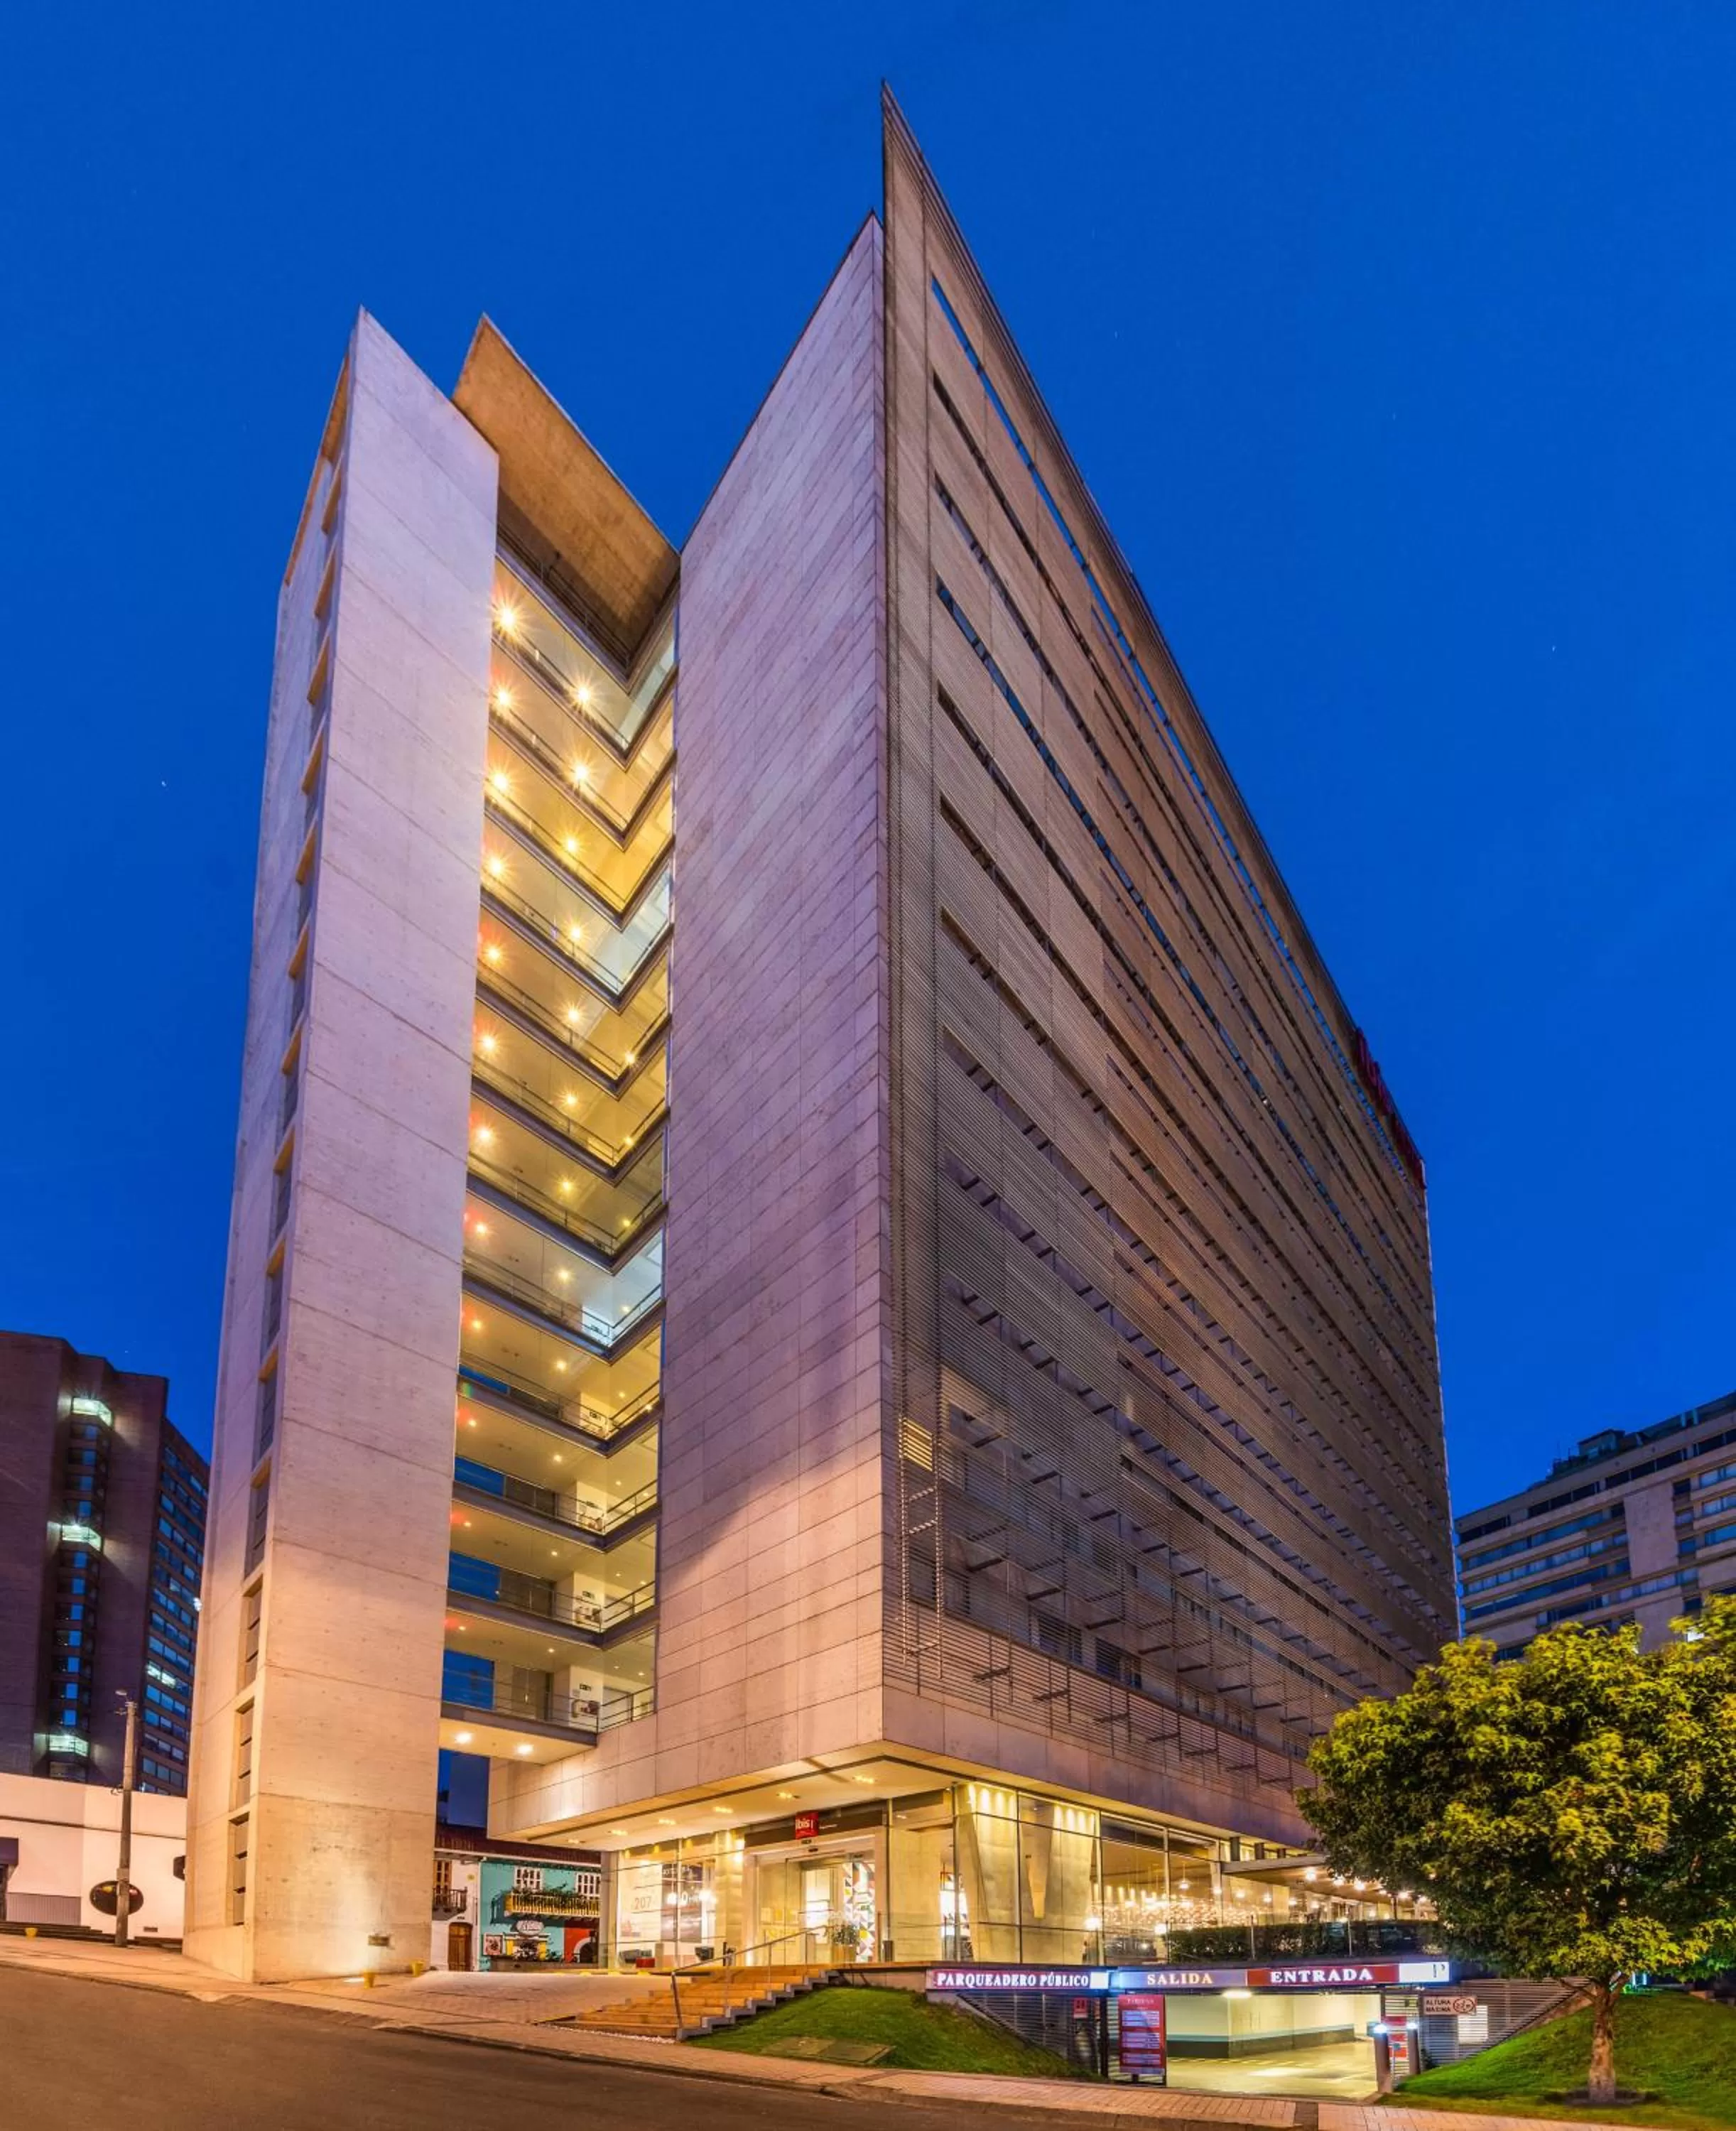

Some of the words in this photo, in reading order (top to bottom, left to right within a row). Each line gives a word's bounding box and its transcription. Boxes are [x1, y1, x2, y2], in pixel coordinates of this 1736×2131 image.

[937, 1972, 1036, 1988] PARQUEADERO
[1039, 1971, 1089, 1987] PÚBLICO
[1147, 1973, 1213, 1985] SALIDA
[1270, 1968, 1374, 1983] ENTRADA
